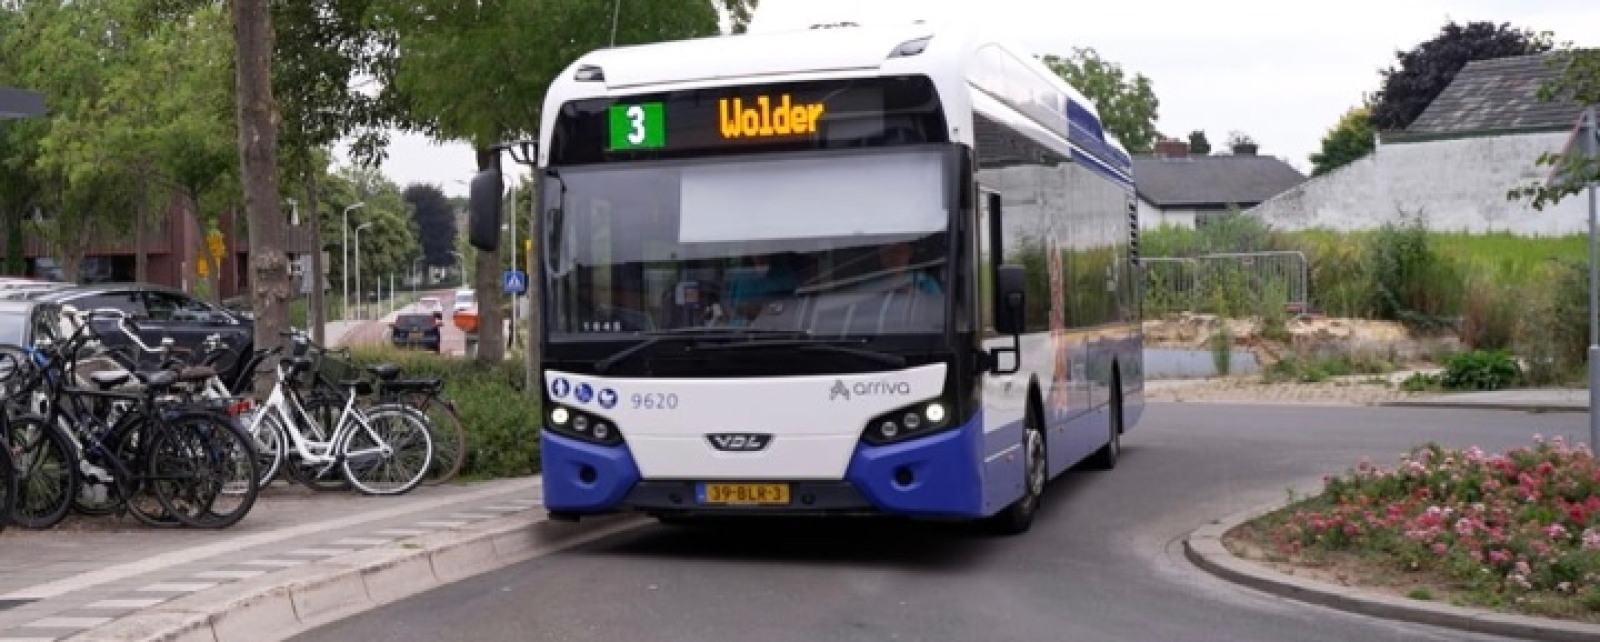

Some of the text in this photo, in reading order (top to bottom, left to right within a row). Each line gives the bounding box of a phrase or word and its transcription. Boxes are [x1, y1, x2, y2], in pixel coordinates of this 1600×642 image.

[626, 94, 824, 145] 3 Wolder
[853, 381, 911, 396] arriva
[630, 393, 679, 409] 9620
[714, 434, 762, 448] VDL
[709, 485, 782, 501] 39-BLR-3
